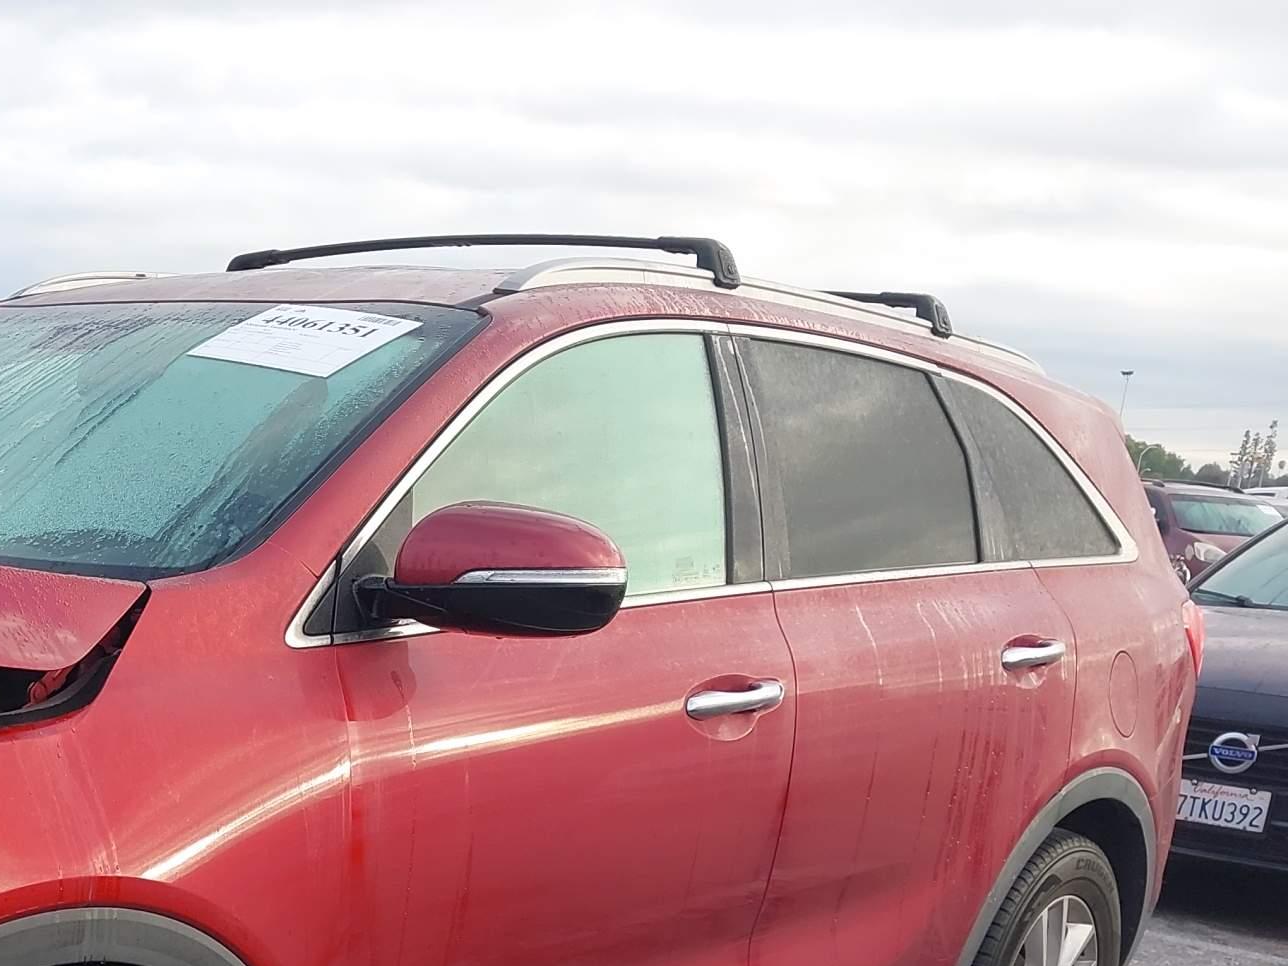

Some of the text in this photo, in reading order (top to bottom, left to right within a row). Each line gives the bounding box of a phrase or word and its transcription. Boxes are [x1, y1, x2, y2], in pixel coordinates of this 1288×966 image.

[262, 315, 379, 338] 44061351
[1213, 747, 1254, 760] VOLVO
[1193, 783, 1254, 801] California
[1177, 794, 1264, 829] 7TKU392
